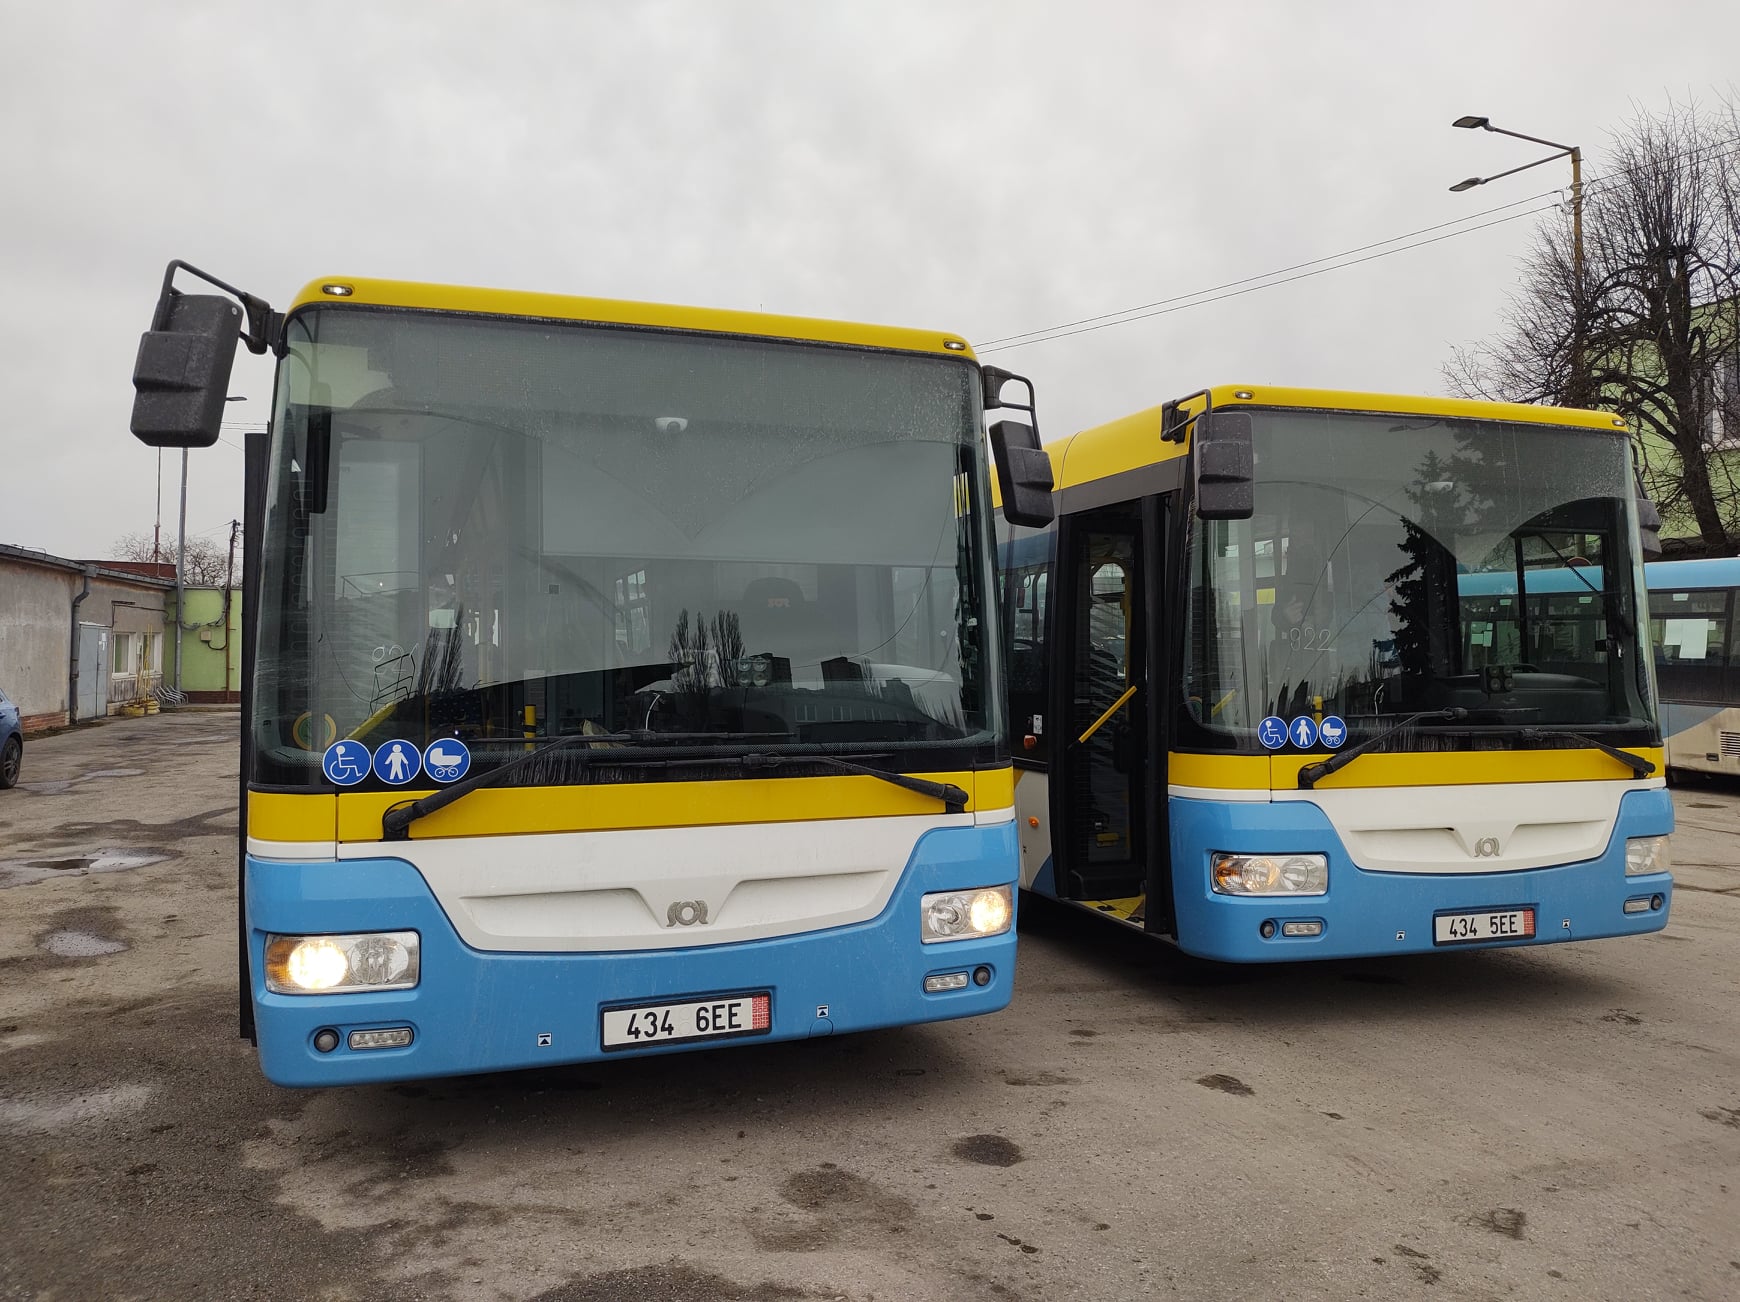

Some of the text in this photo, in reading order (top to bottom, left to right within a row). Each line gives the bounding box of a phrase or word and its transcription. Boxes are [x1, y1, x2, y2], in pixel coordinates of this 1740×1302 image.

[1290, 627, 1337, 652] 922
[1449, 917, 1478, 938] 434
[1489, 914, 1518, 935] 5EE
[627, 1009, 675, 1040] 434
[695, 1002, 742, 1032] 6EE
